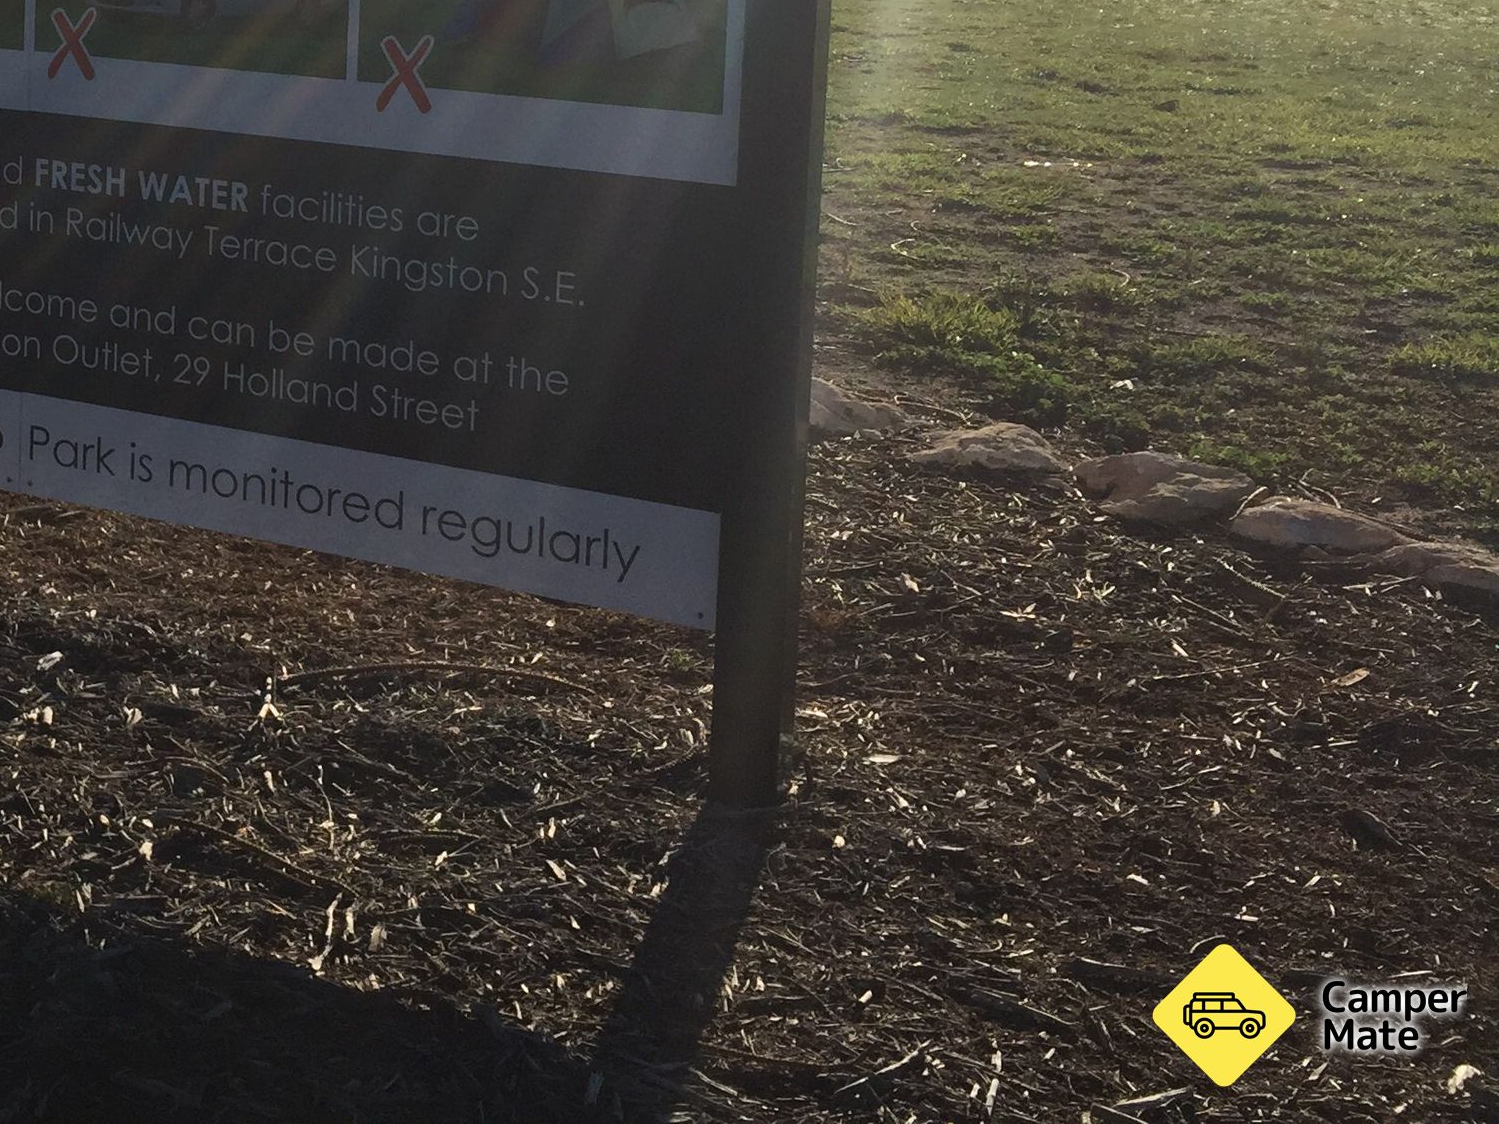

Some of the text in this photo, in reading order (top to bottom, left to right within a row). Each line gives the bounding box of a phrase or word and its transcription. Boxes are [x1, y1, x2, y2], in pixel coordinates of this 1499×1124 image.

[35, 157, 127, 198] FRESH
[138, 172, 249, 212] WATER
[260, 184, 403, 232] facilities
[417, 211, 479, 241] are
[29, 202, 54, 236] in
[65, 207, 192, 259] Railway
[203, 225, 337, 273] Terrace
[350, 244, 509, 296] Kingston
[521, 267, 586, 307] S.E.
[52, 335, 161, 383] Outlet,
[172, 354, 213, 386] 29
[223, 363, 359, 413] Holland
[370, 385, 479, 432] Street
[109, 303, 176, 336] and
[187, 316, 256, 348] can
[269, 320, 315, 358] be
[328, 338, 441, 376] made
[453, 352, 494, 385] at
[505, 356, 569, 397] the
[28, 424, 642, 584] Park is monitored regularly
